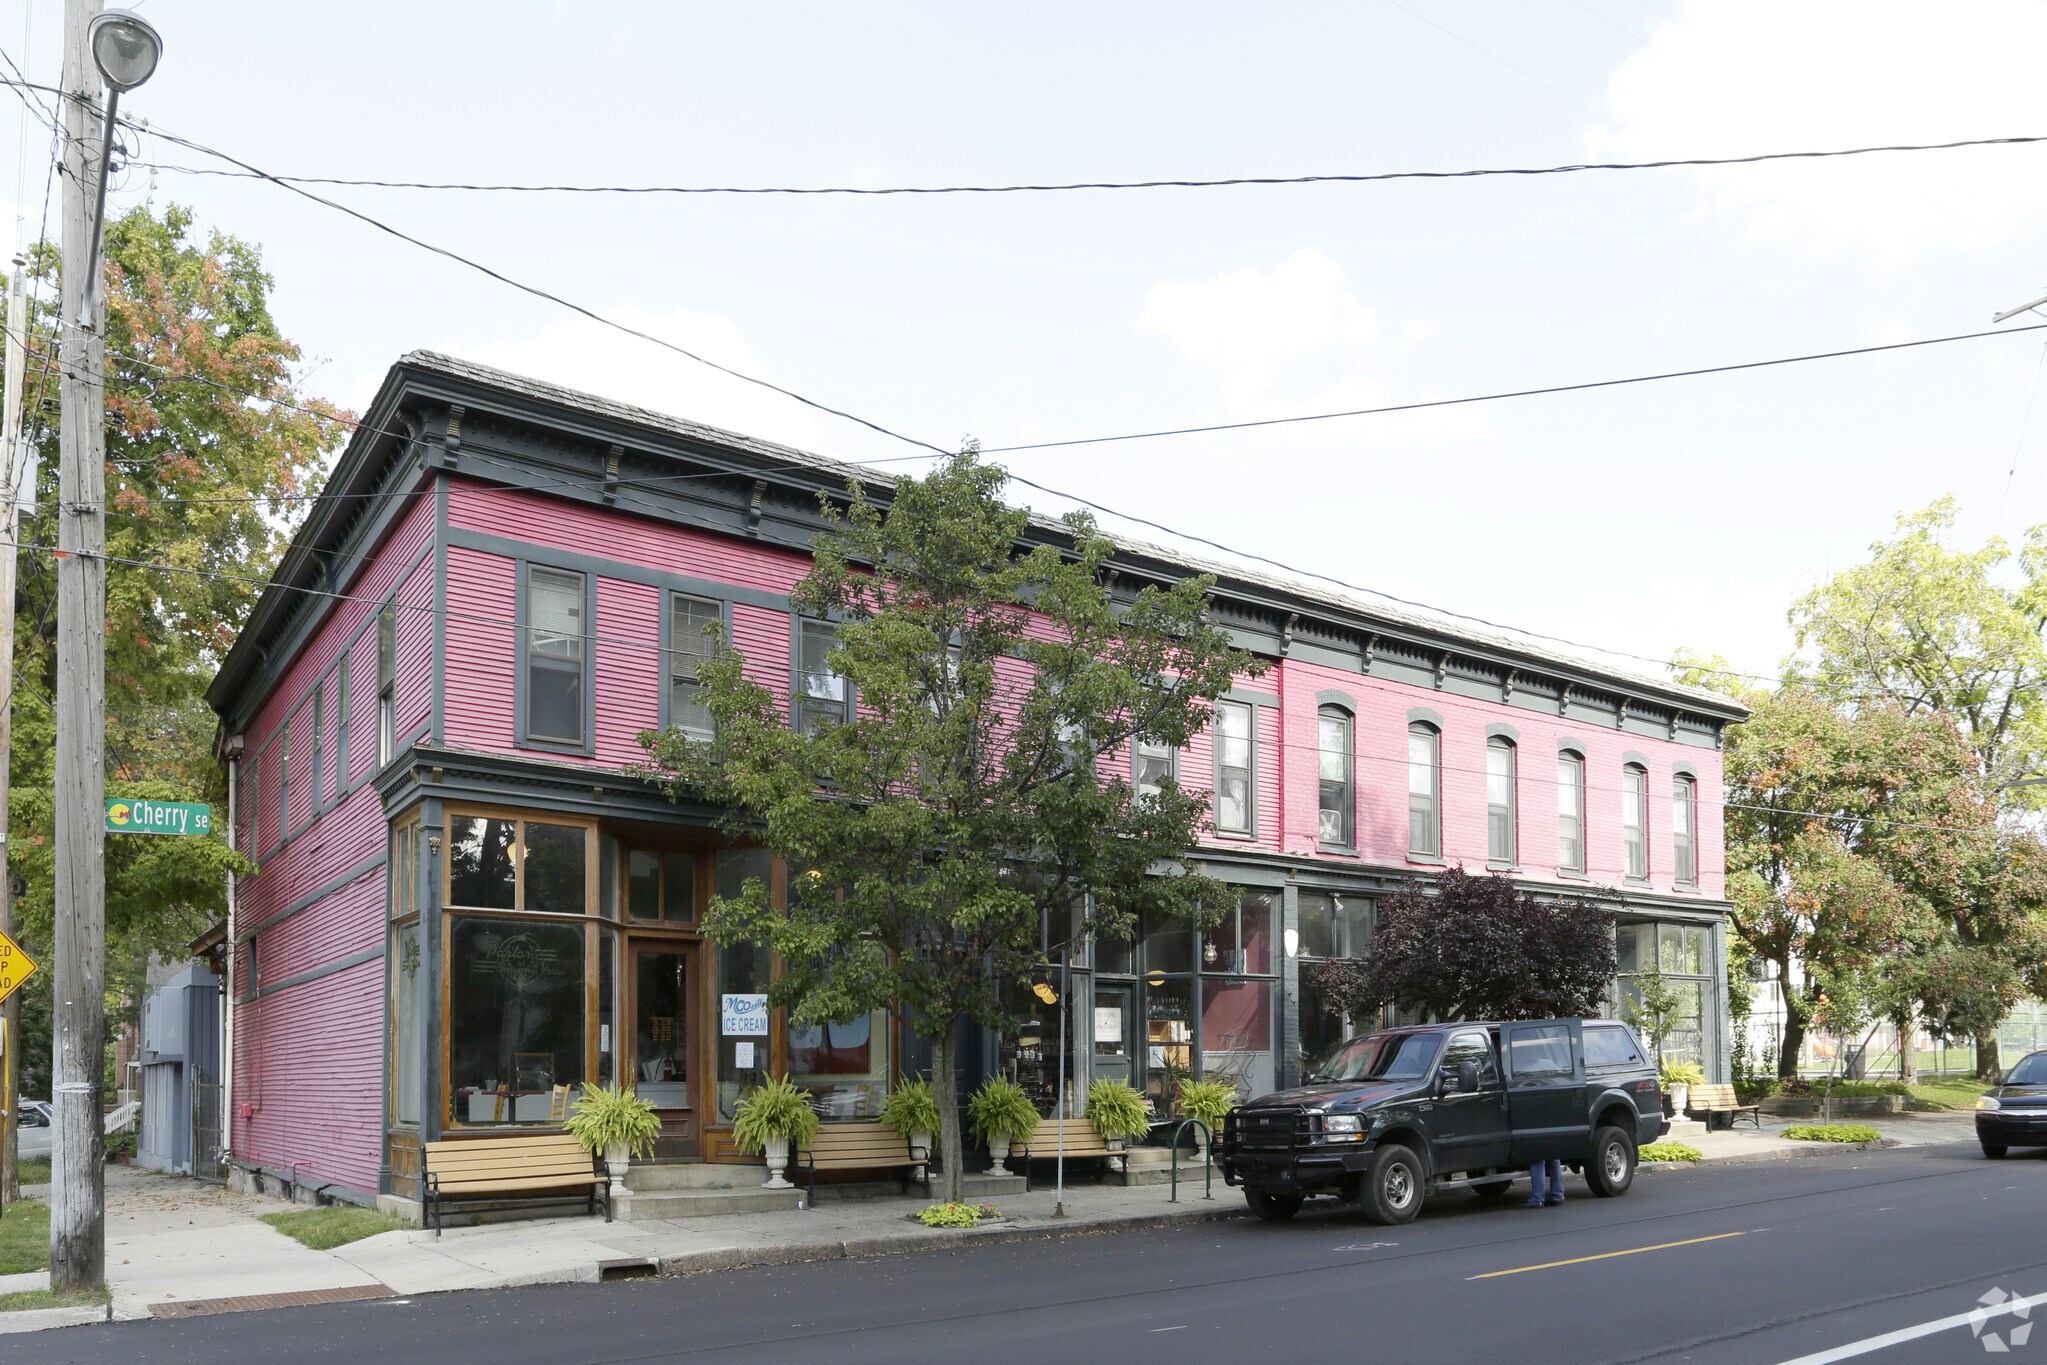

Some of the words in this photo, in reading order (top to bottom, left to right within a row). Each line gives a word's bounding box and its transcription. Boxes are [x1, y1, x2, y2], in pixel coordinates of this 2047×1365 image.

[133, 801, 188, 833] Cherry
[487, 943, 531, 959] Parlor
[723, 1017, 736, 1032] ICE
[738, 1017, 767, 1032] CREAM
